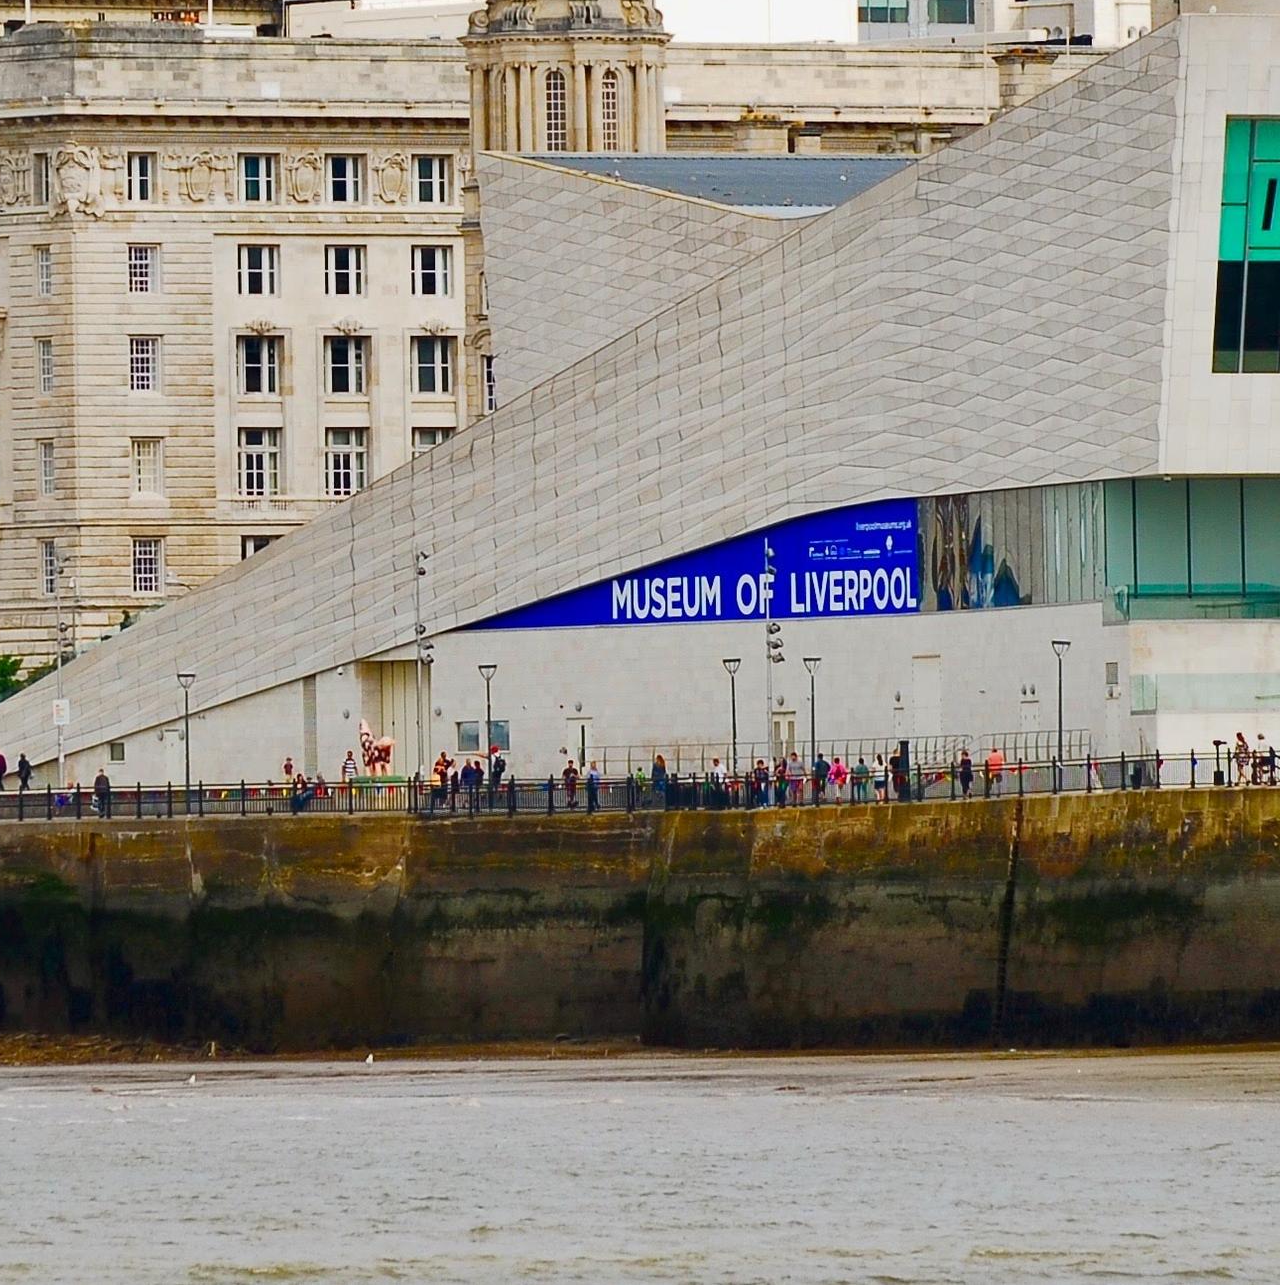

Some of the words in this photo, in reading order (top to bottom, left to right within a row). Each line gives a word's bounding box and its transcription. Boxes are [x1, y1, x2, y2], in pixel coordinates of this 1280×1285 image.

[612, 576, 721, 619] MUSEUM
[736, 573, 775, 615] OF
[790, 567, 917, 613] LIVERPOOL
